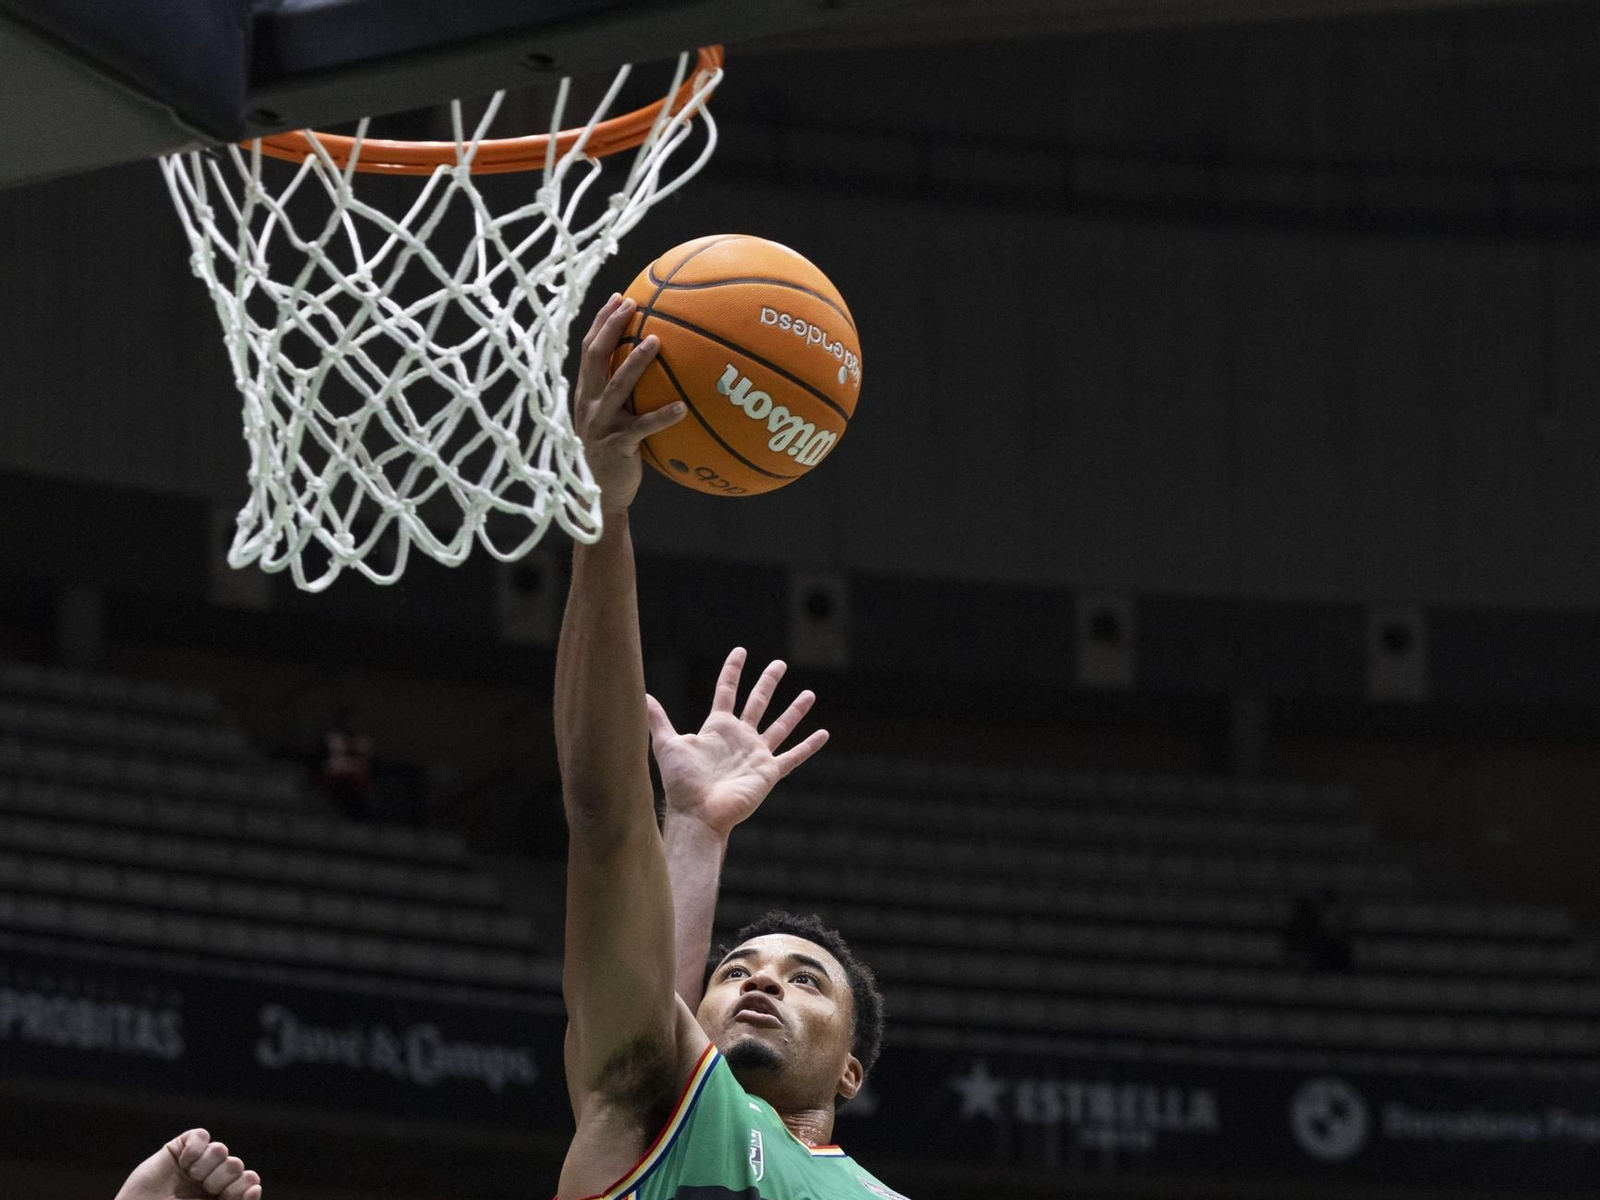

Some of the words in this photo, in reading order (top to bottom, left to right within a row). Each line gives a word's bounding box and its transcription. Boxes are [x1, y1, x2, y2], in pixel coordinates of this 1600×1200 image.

[760, 306, 844, 359] endesa
[716, 363, 837, 466] Wilson
[694, 466, 747, 494] acb
